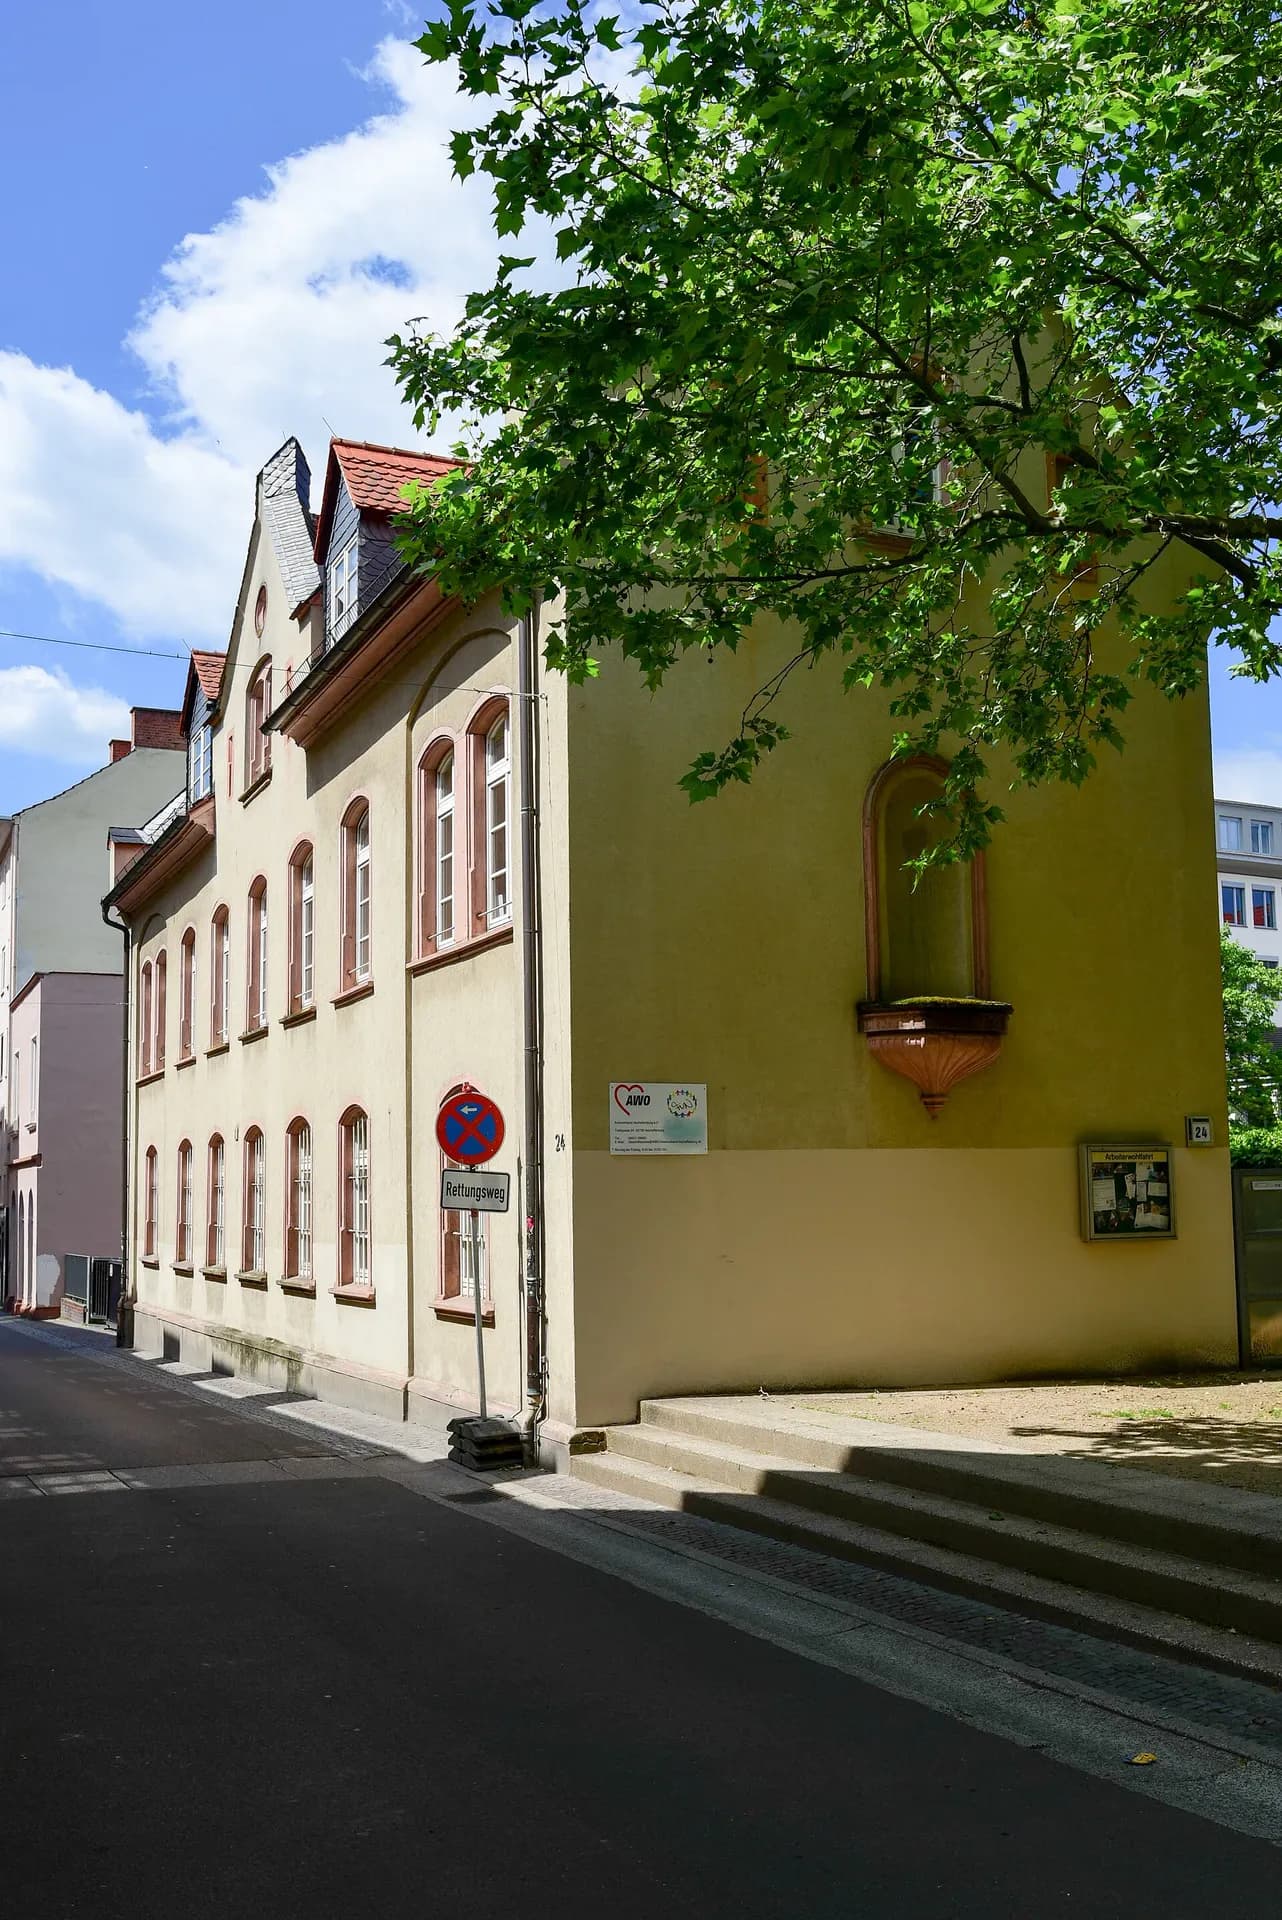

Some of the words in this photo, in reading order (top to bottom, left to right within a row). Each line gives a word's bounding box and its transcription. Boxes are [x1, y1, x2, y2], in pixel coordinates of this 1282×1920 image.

[625, 1095, 651, 1106] AWO
[1195, 1127, 1208, 1140] 24
[554, 1133, 566, 1152] 24
[446, 1181, 505, 1203] Rettungsweg
